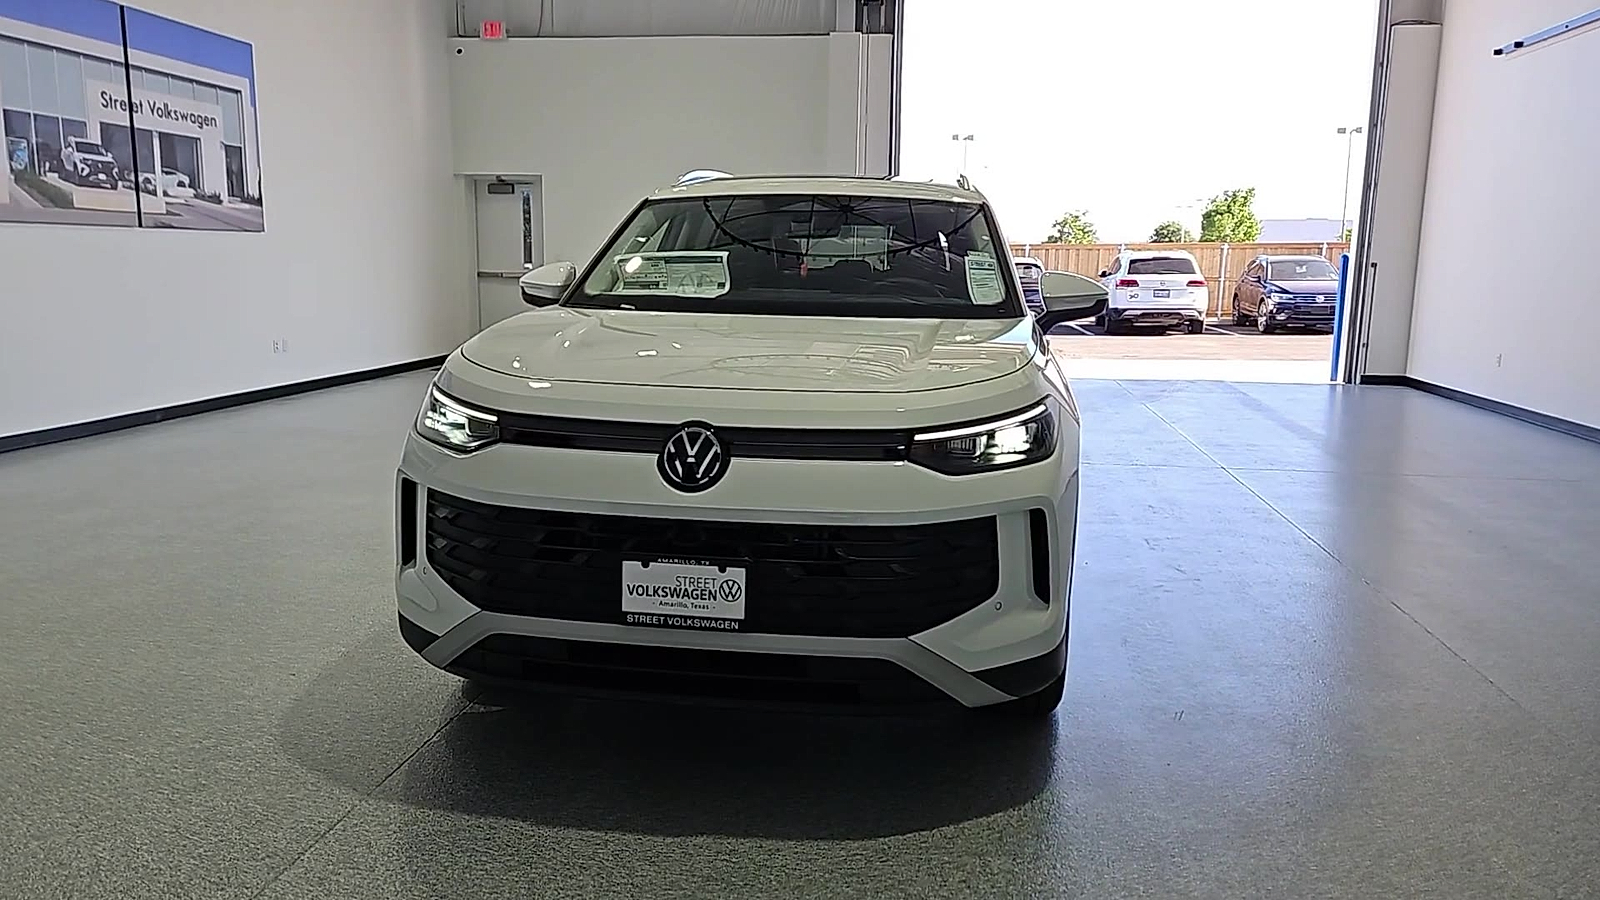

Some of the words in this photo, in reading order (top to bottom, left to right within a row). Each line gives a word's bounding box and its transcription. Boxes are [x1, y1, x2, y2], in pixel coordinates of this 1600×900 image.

[100, 90, 144, 115] Street
[147, 99, 219, 129] Volkswagen
[675, 575, 718, 589] STREET
[626, 583, 718, 602] VOLKSWAGEN
[658, 600, 690, 609] Amarillo,
[690, 602, 710, 610] Texas
[626, 614, 665, 625] STREET
[667, 617, 739, 630] VOLKSWAGEN
